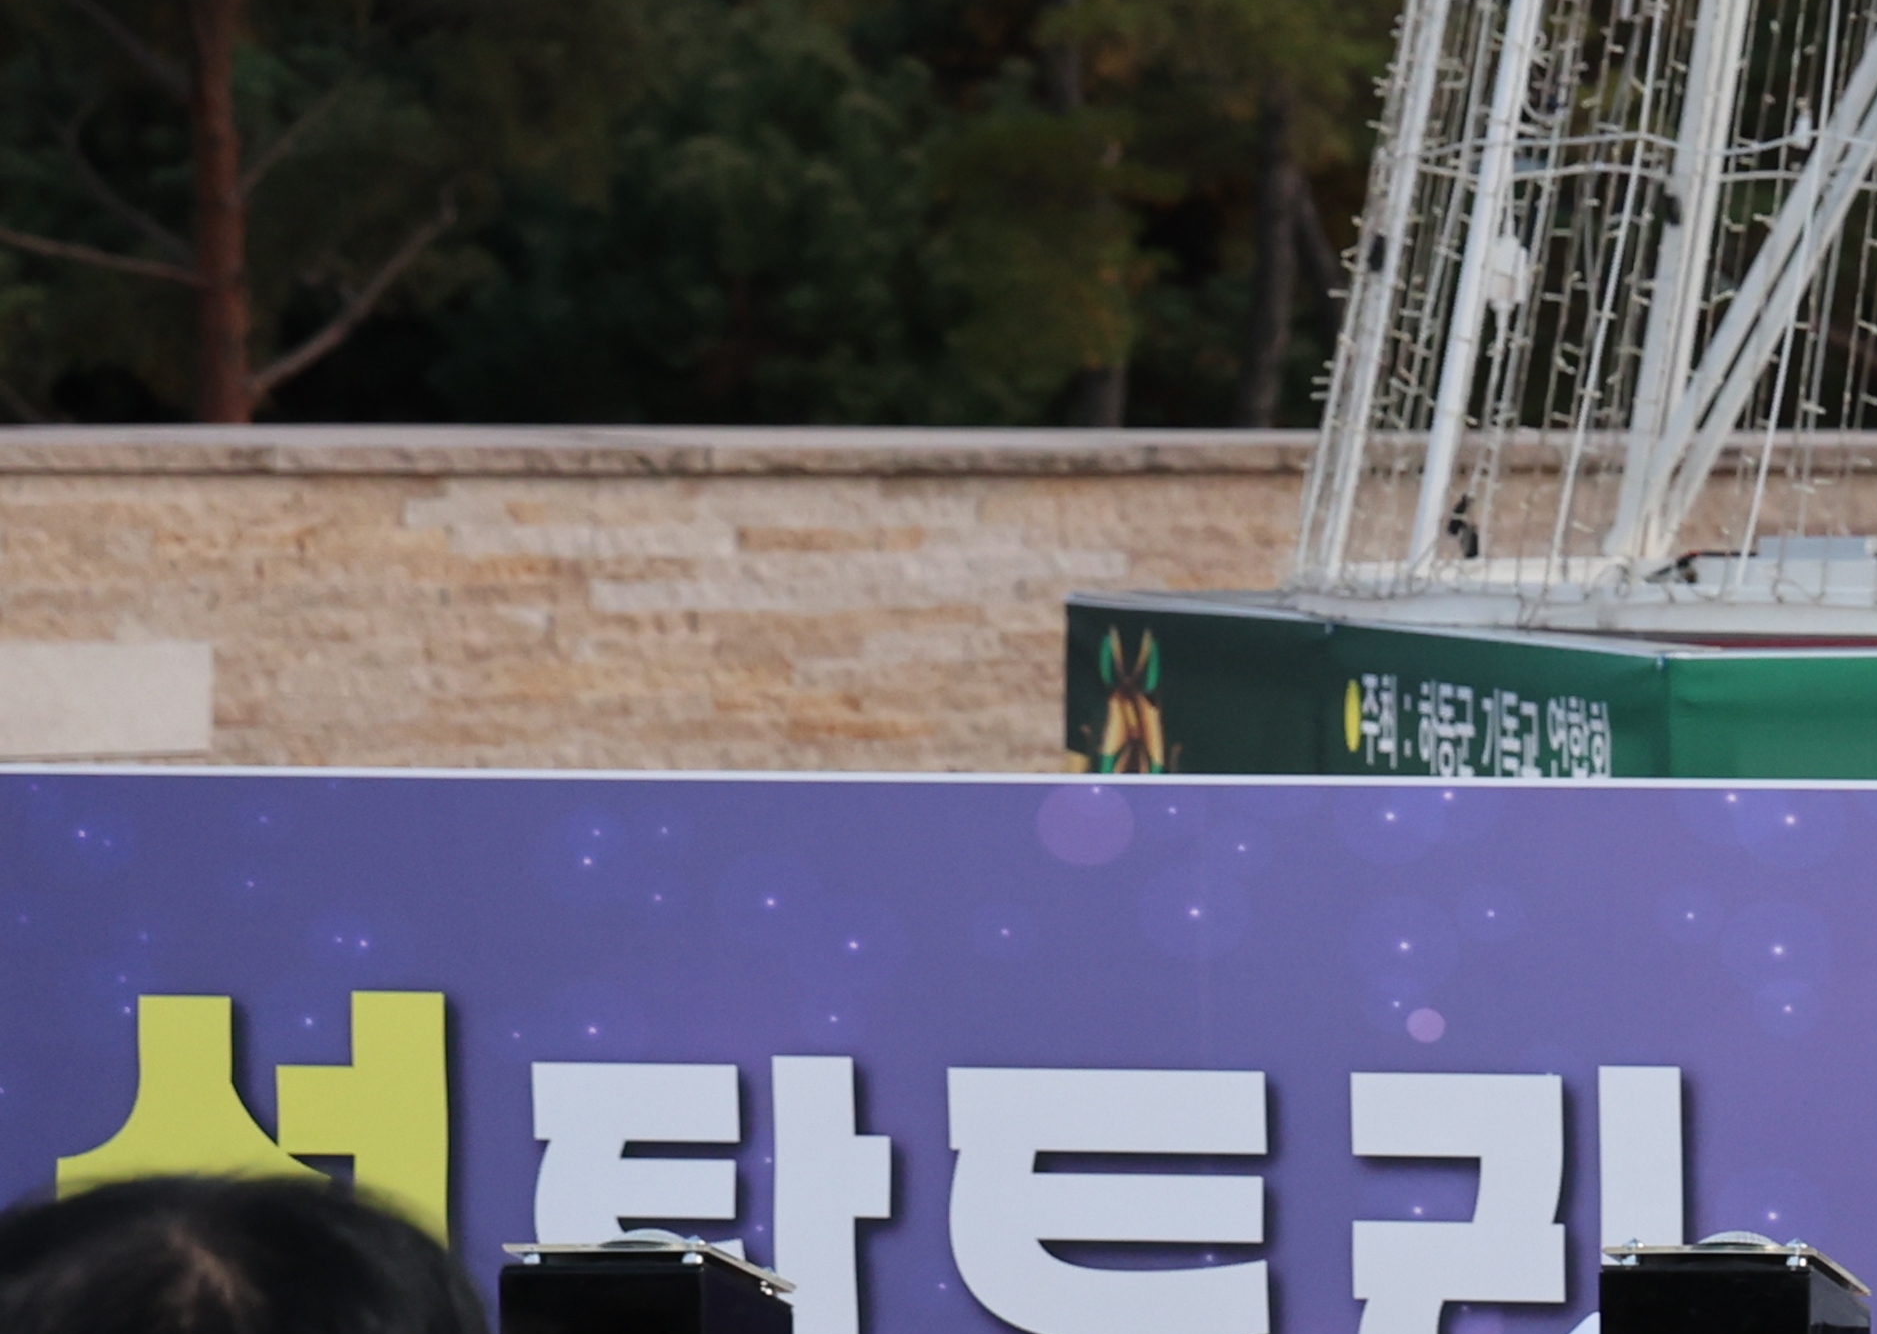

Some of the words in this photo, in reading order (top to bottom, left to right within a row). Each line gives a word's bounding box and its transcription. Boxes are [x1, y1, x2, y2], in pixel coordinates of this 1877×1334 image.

[1417, 678, 1476, 778] 하동군
[1481, 687, 1543, 778] 기독교
[1546, 694, 1613, 778] 연합회
